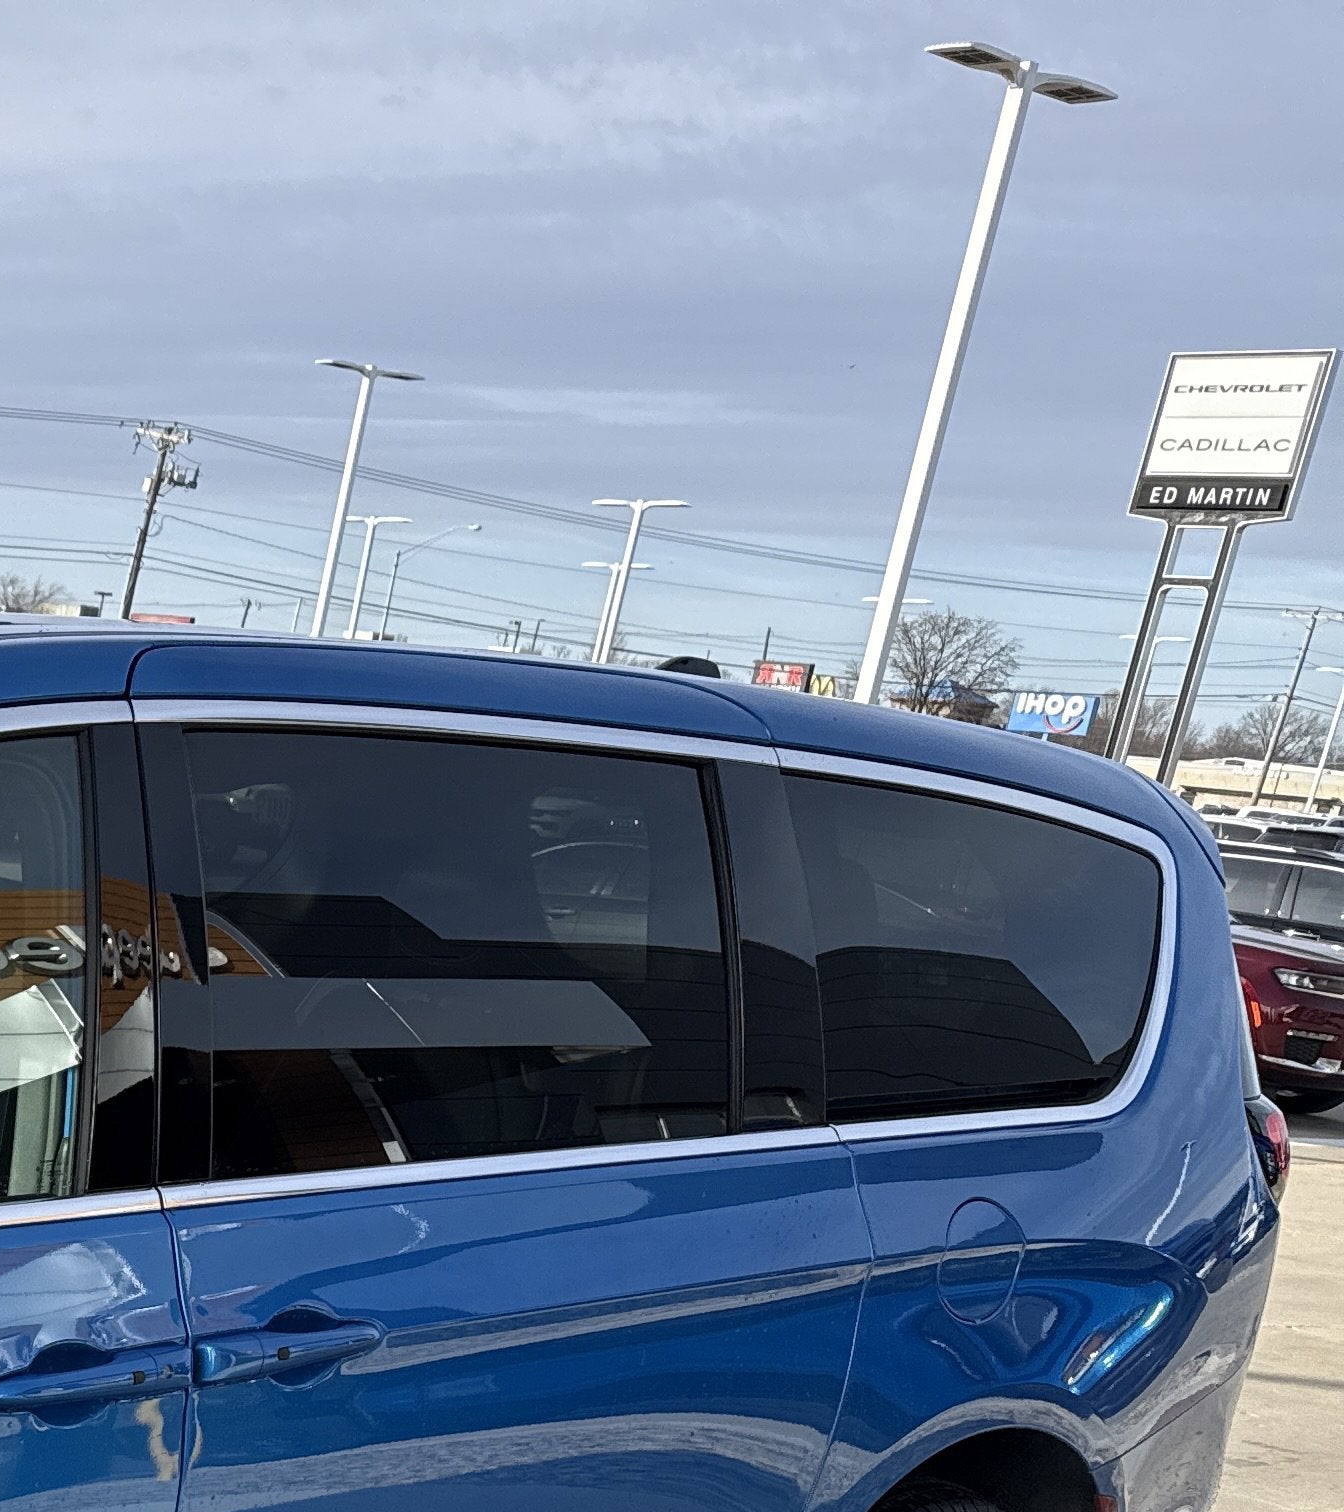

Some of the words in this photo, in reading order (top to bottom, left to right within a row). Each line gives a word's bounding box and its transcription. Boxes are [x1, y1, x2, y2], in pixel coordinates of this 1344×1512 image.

[1173, 384, 1308, 393] CHEVROLET
[1160, 438, 1291, 452] CADILLAC
[1149, 487, 1178, 504] ED
[1186, 487, 1272, 506] MARTIN
